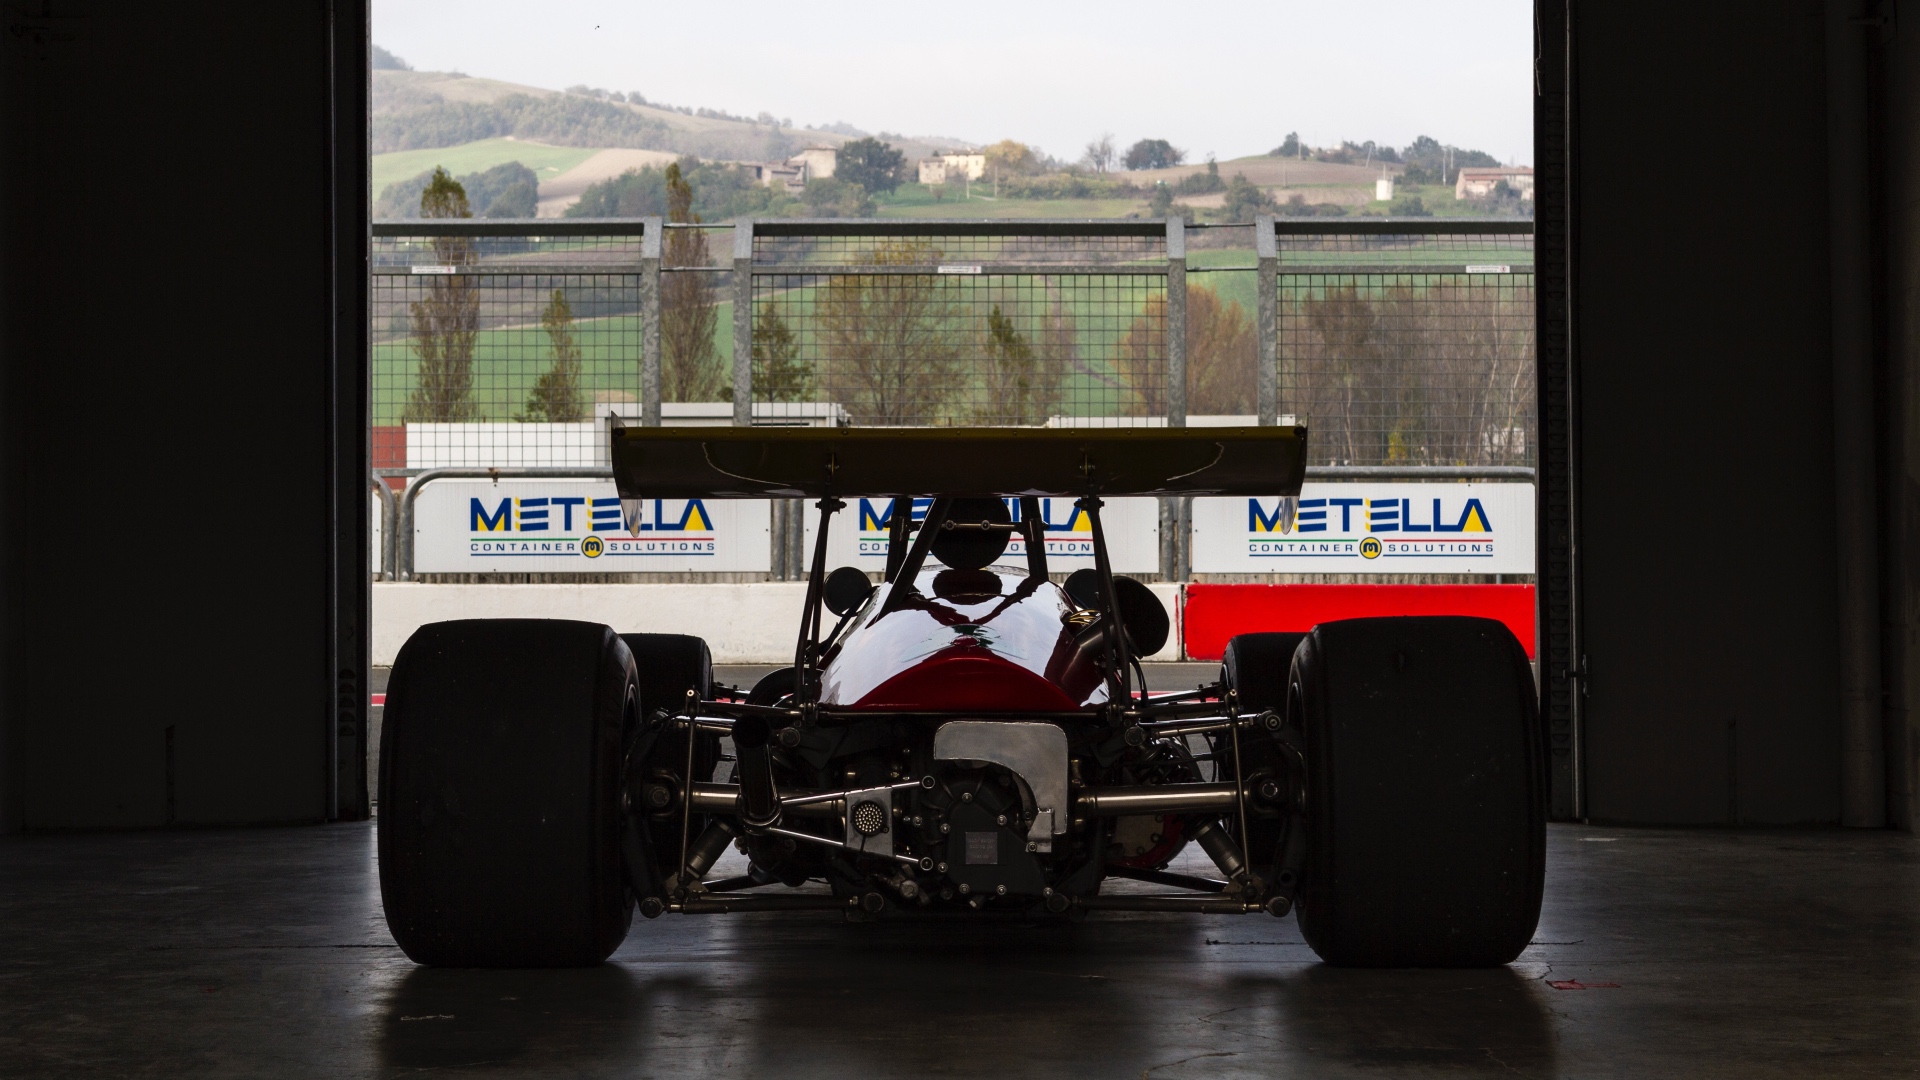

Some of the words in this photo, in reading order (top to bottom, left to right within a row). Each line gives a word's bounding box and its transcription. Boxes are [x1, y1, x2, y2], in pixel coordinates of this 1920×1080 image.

[1249, 498, 1493, 532] METELLA
[470, 542, 575, 551] CONTAINER
[610, 542, 715, 551] SOLUTIONS
[1249, 543, 1353, 552] CONTAINER
[1388, 543, 1494, 552] SOLUTIONS
